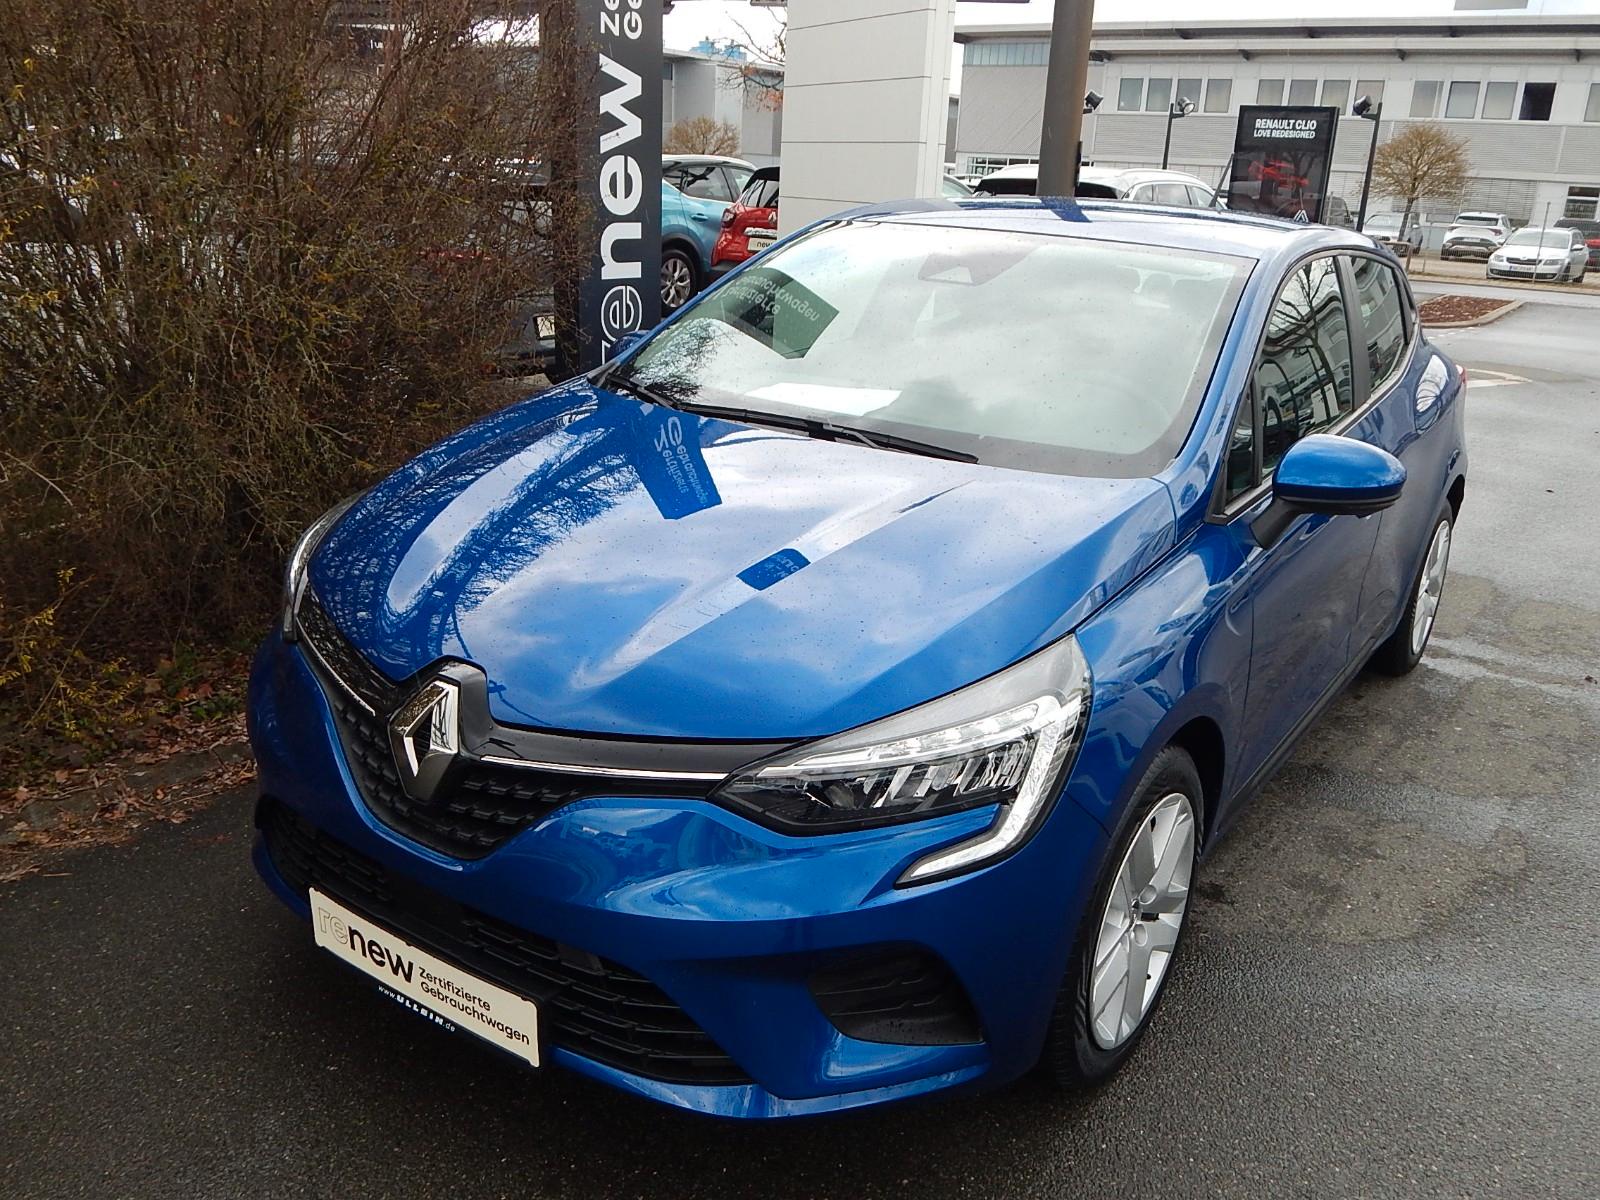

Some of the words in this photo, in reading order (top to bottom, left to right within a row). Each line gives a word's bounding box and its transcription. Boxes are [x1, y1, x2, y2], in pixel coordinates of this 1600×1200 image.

[1253, 129, 1271, 138] LOVE
[1271, 130, 1316, 139] REDESIGNED
[1255, 119, 1294, 130] RENAULT
[1295, 120, 1317, 130] CLIO
[317, 907, 414, 984] renew
[418, 966, 491, 1011] Zertifizierte
[420, 981, 530, 1045] Gebrauchtwagen
